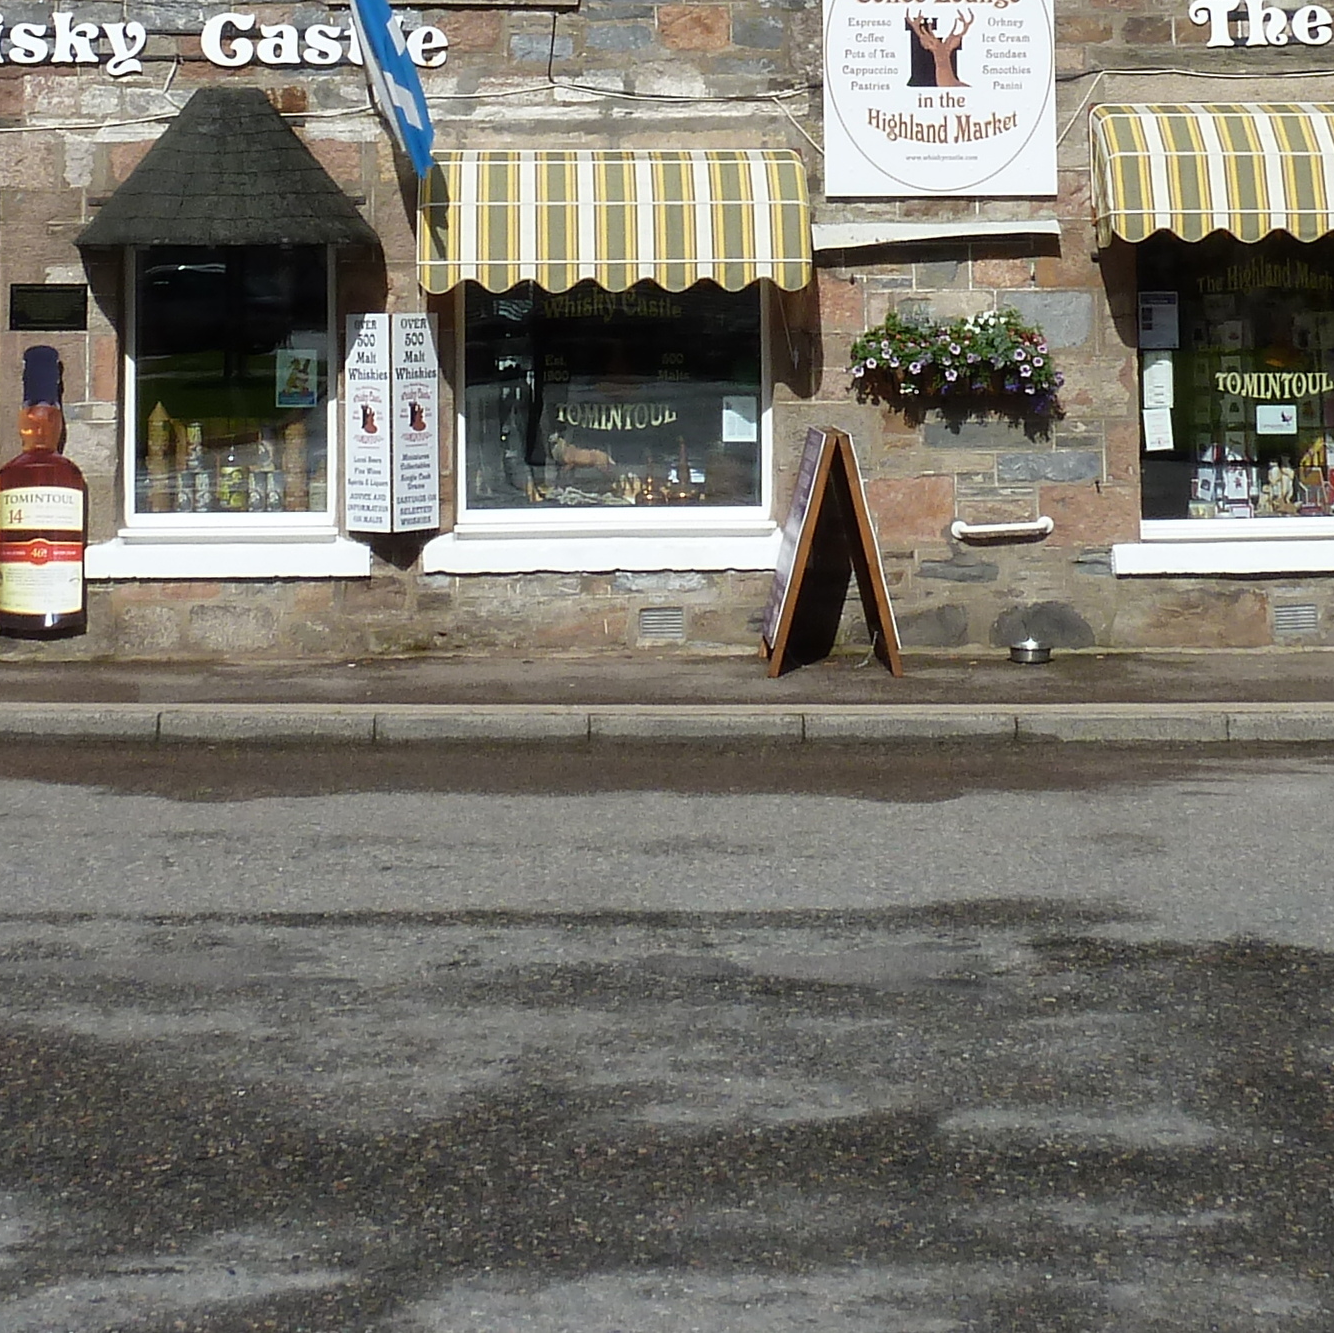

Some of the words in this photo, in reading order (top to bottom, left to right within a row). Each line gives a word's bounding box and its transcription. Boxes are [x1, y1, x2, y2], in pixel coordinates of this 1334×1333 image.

[848, 17, 892, 29] Espresso
[987, 17, 1024, 29] Orkney
[855, 33, 885, 43] Coffee
[982, 33, 996, 43] Ice
[998, 33, 1030, 43] Cream
[845, 49, 866, 59] Pots
[868, 49, 878, 59] of
[880, 49, 896, 59] Tea
[985, 49, 1027, 59] Sundaes
[842, 66, 898, 77] Cappuccino
[982, 65, 1031, 75] Smoothies
[851, 81, 891, 91] Pastries
[993, 81, 1023, 90] Panini
[918, 93, 933, 108] in
[939, 92, 965, 108] the
[868, 108, 948, 144] Highland
[954, 110, 1018, 144] Market
[1227, 255, 1291, 295] Highland
[354, 319, 377, 330] OVER
[401, 318, 427, 329] OVER
[357, 333, 375, 347] 500
[405, 332, 424, 346] 500
[355, 351, 376, 363] Malt
[403, 350, 425, 363] Malt
[348, 368, 387, 380] Whiskies
[395, 367, 436, 380] Whiskies
[1215, 371, 1334, 400] TOMINTOUL
[556, 403, 677, 431] TOMINTOUL
[4, 493, 75, 505] TOMINTOUL
[8, 509, 23, 524] 14
